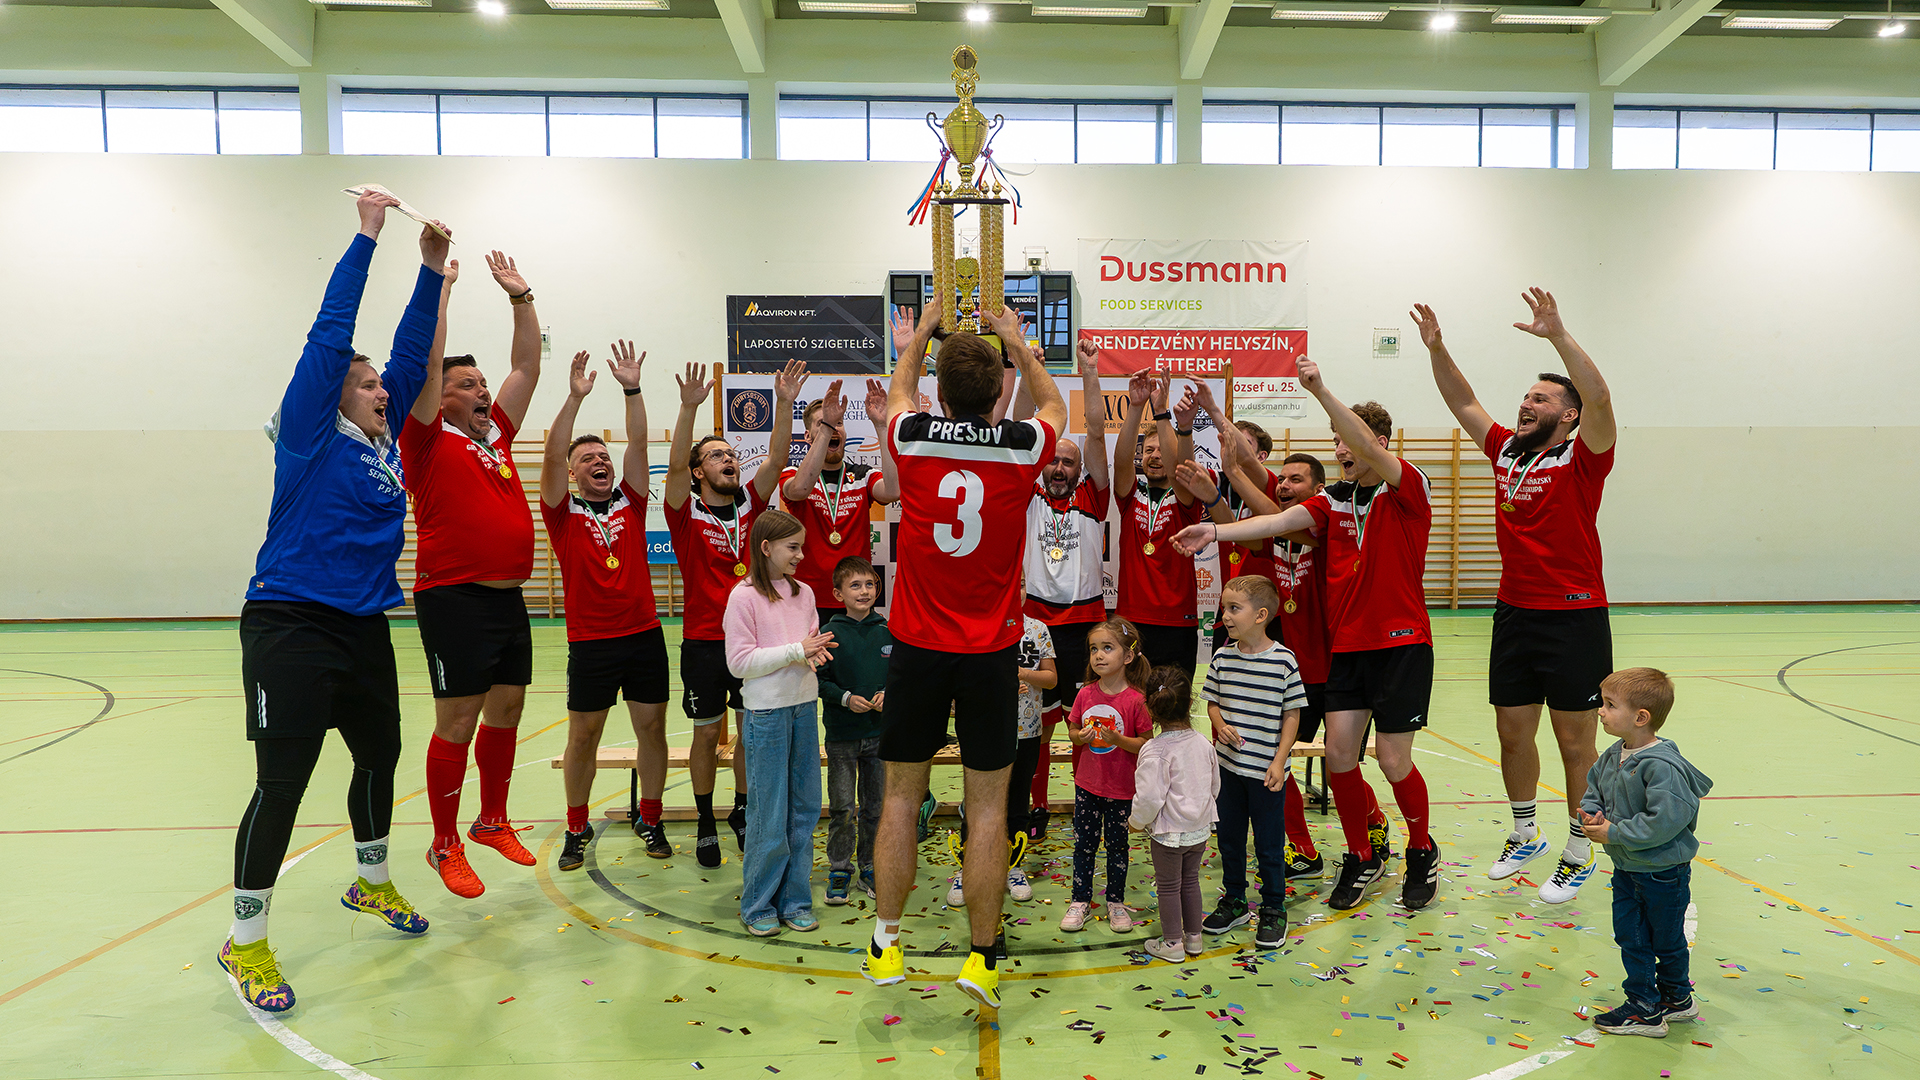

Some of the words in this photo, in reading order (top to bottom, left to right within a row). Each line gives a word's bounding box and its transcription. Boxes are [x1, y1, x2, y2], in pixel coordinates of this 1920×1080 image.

[1101, 255, 1287, 283] Dussmann
[1100, 299, 1136, 310] FOOD
[1140, 299, 1203, 311] SERVICES
[811, 337, 875, 349] SZIGETELÉS
[1093, 333, 1206, 350] RENDEZVÉNY
[1211, 333, 1294, 353] HELYSZÍN,
[1155, 354, 1232, 372] ÉTTEREM
[1233, 381, 1265, 392] ózsef
[1267, 384, 1278, 392] u.
[1281, 382, 1298, 392] 25.
[933, 469, 985, 558] 3
